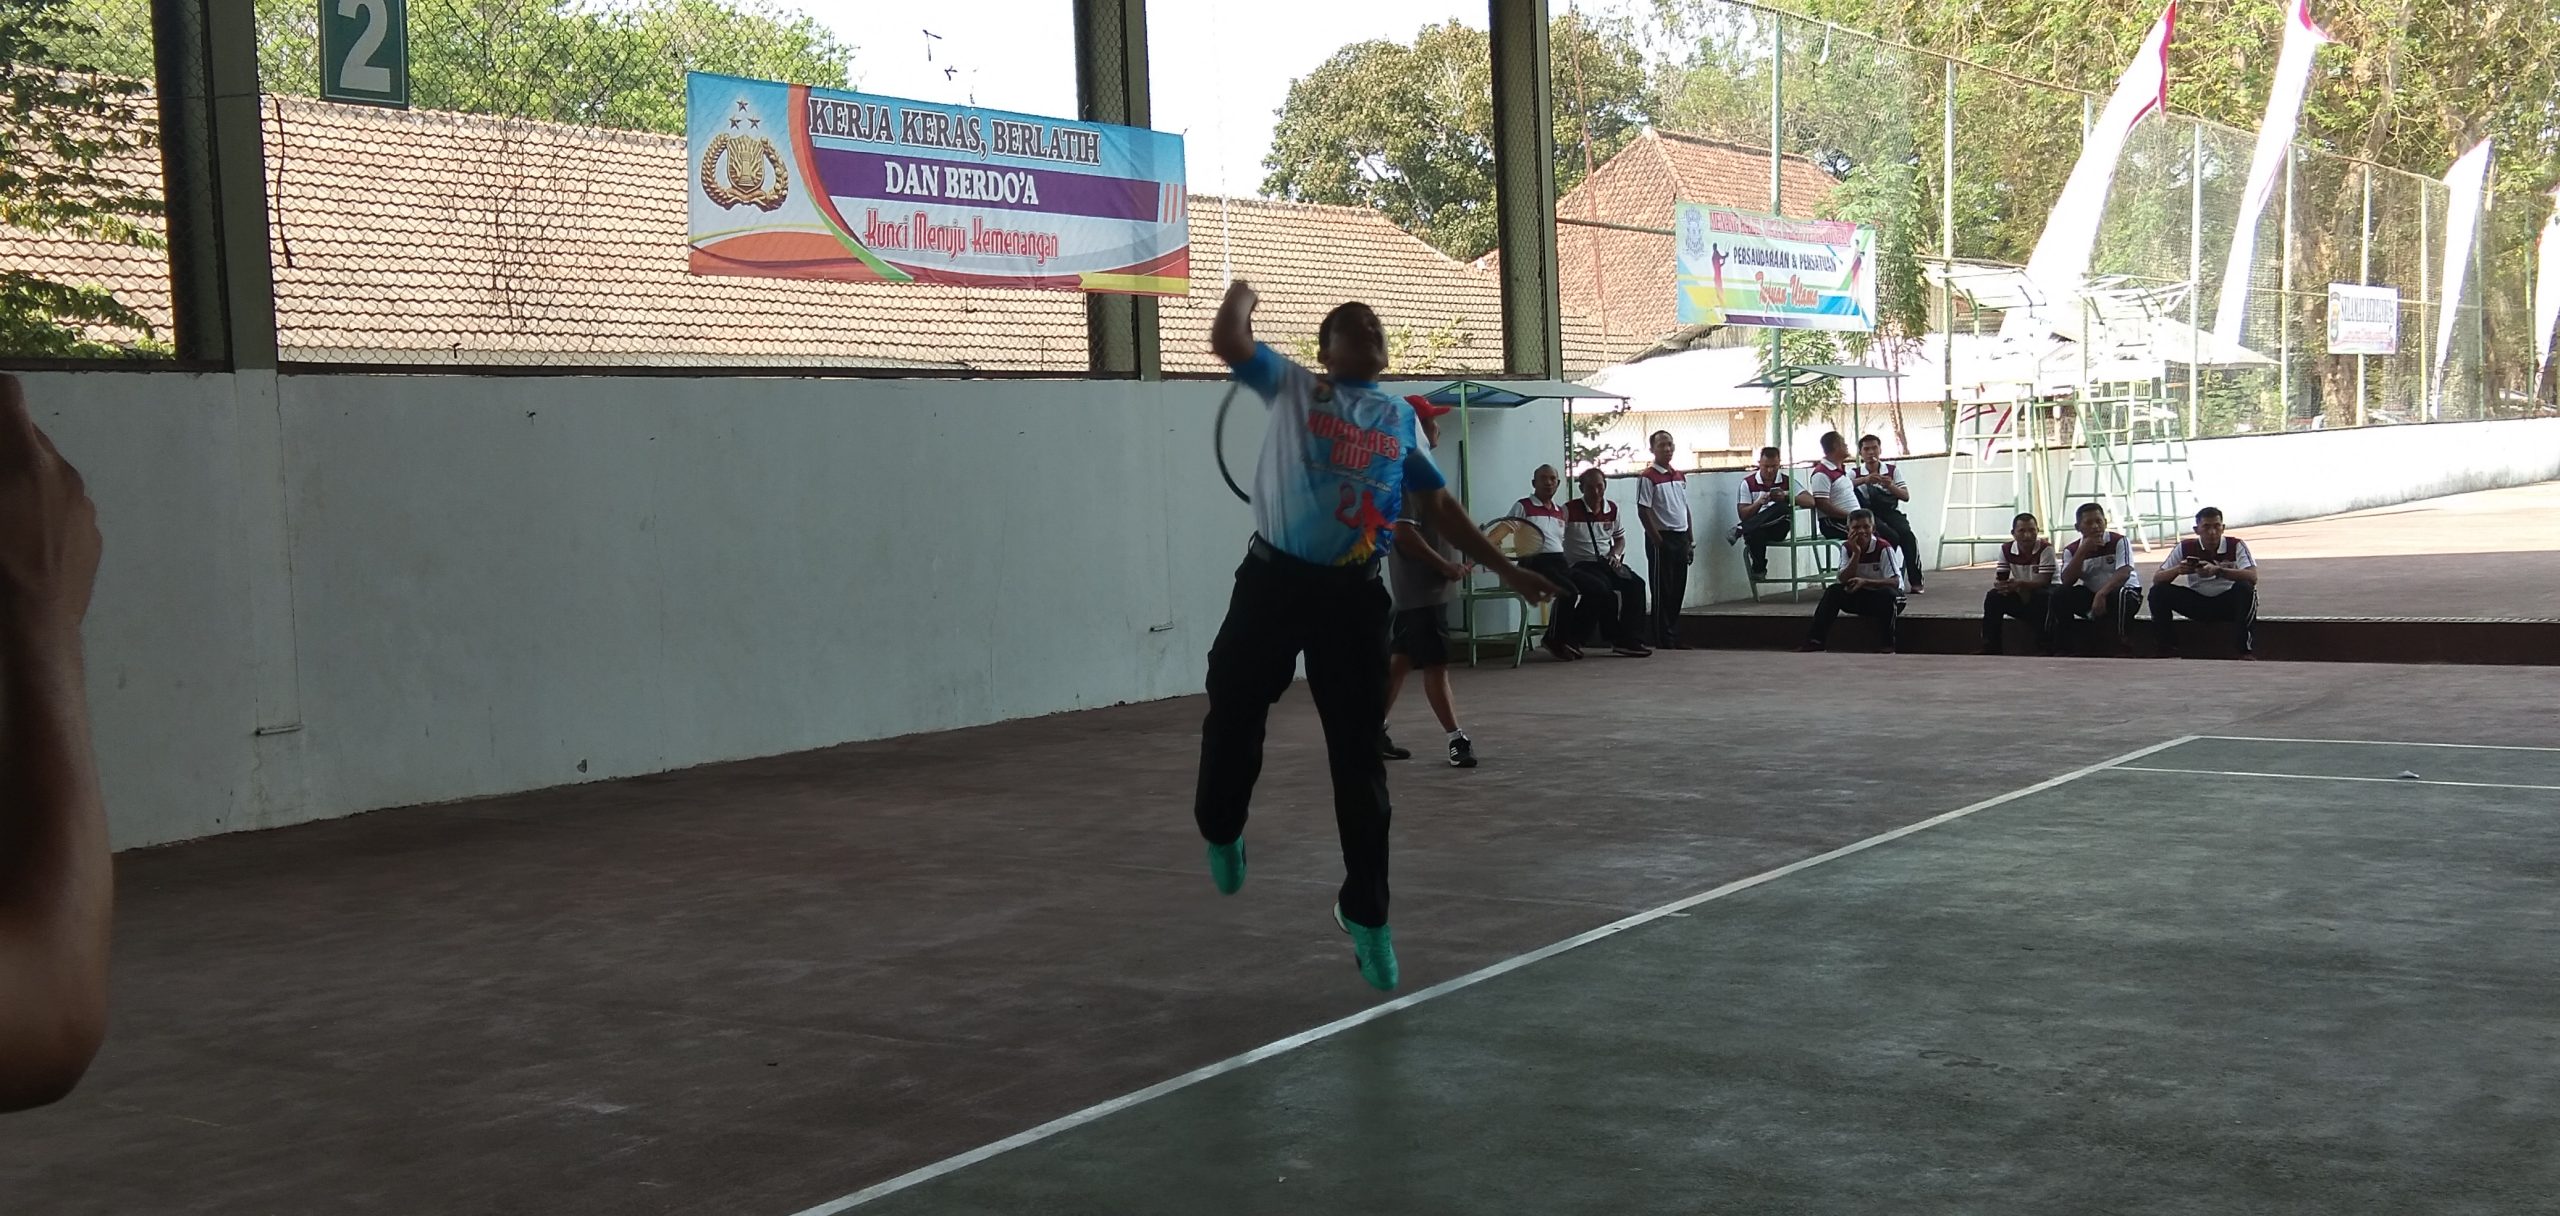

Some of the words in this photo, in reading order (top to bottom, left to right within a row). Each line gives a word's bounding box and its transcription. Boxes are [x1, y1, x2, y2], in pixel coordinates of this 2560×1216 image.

[338, 0, 391, 93] 2
[807, 97, 894, 144] KERJA
[898, 108, 988, 160] KERAS,
[990, 119, 1102, 166] BERLATIH
[884, 160, 939, 198] DAN
[943, 166, 1040, 206] BERDO'A
[863, 208, 909, 248] Kunci
[911, 210, 967, 261] Menuju
[970, 216, 1061, 267] Kemenangan
[1733, 246, 1790, 269] PERSAUDARAAN
[1791, 253, 1798, 270] &
[1799, 254, 1837, 272] PERSATUAN
